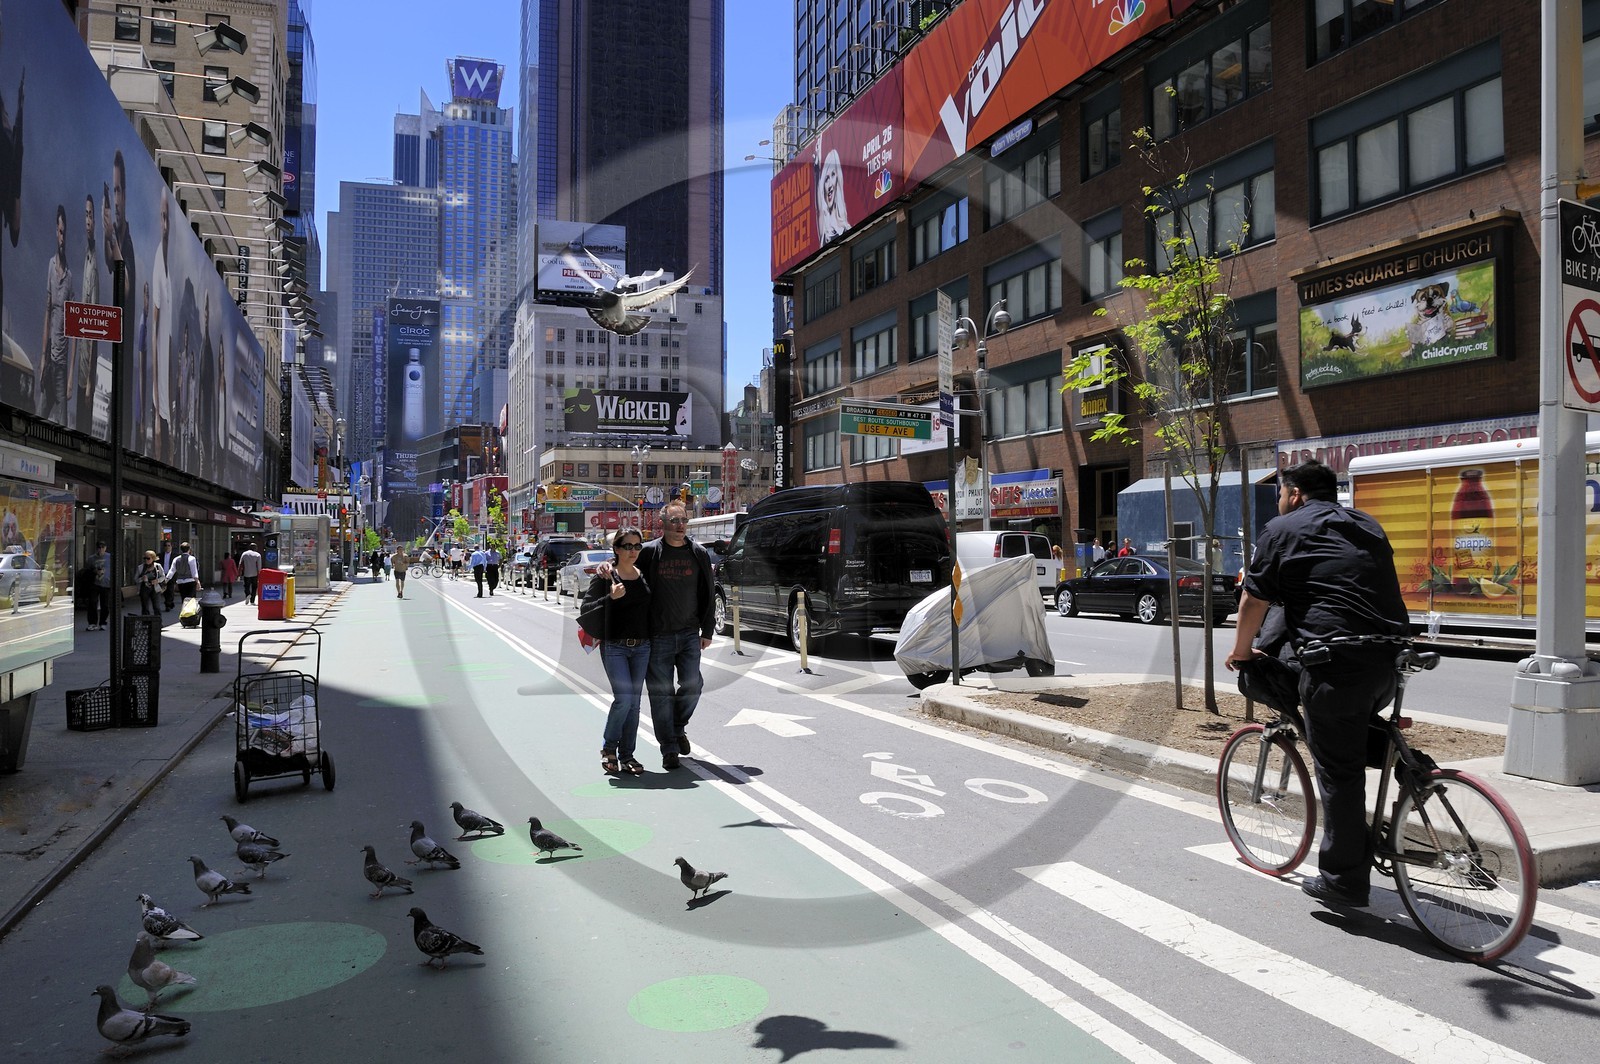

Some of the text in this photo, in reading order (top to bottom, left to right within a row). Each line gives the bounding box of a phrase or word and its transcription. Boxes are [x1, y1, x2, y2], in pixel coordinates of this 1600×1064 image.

[459, 66, 493, 93] W
[1006, 121, 1031, 142] Wagner
[862, 124, 892, 161] APRIL 26
[866, 155, 881, 177] TUES
[773, 163, 810, 217] DEMAND
[774, 209, 811, 268] VOICE!
[1303, 236, 1491, 300] TIMES SQUARE CHURCH
[1565, 259, 1587, 279] BIKE
[69, 306, 117, 318] NO STOPPING
[1334, 314, 1349, 322] book
[1362, 307, 1376, 317] feed
[79, 317, 109, 327] ANYTIME
[1422, 341, 1488, 360] ChildCrynyc.org
[374, 318, 384, 424] TIMES SQUARE
[1081, 398, 1108, 417] annex
[864, 425, 908, 435] USE 7 AVE
[886, 418, 920, 427] SOUTHBOUND
[776, 425, 784, 488] McDonald's
[968, 489, 984, 498] PHANT
[990, 485, 1056, 507] GIFTS LUGGAGE
[967, 507, 984, 516] BROAD
[1455, 537, 1492, 551] Snapple
